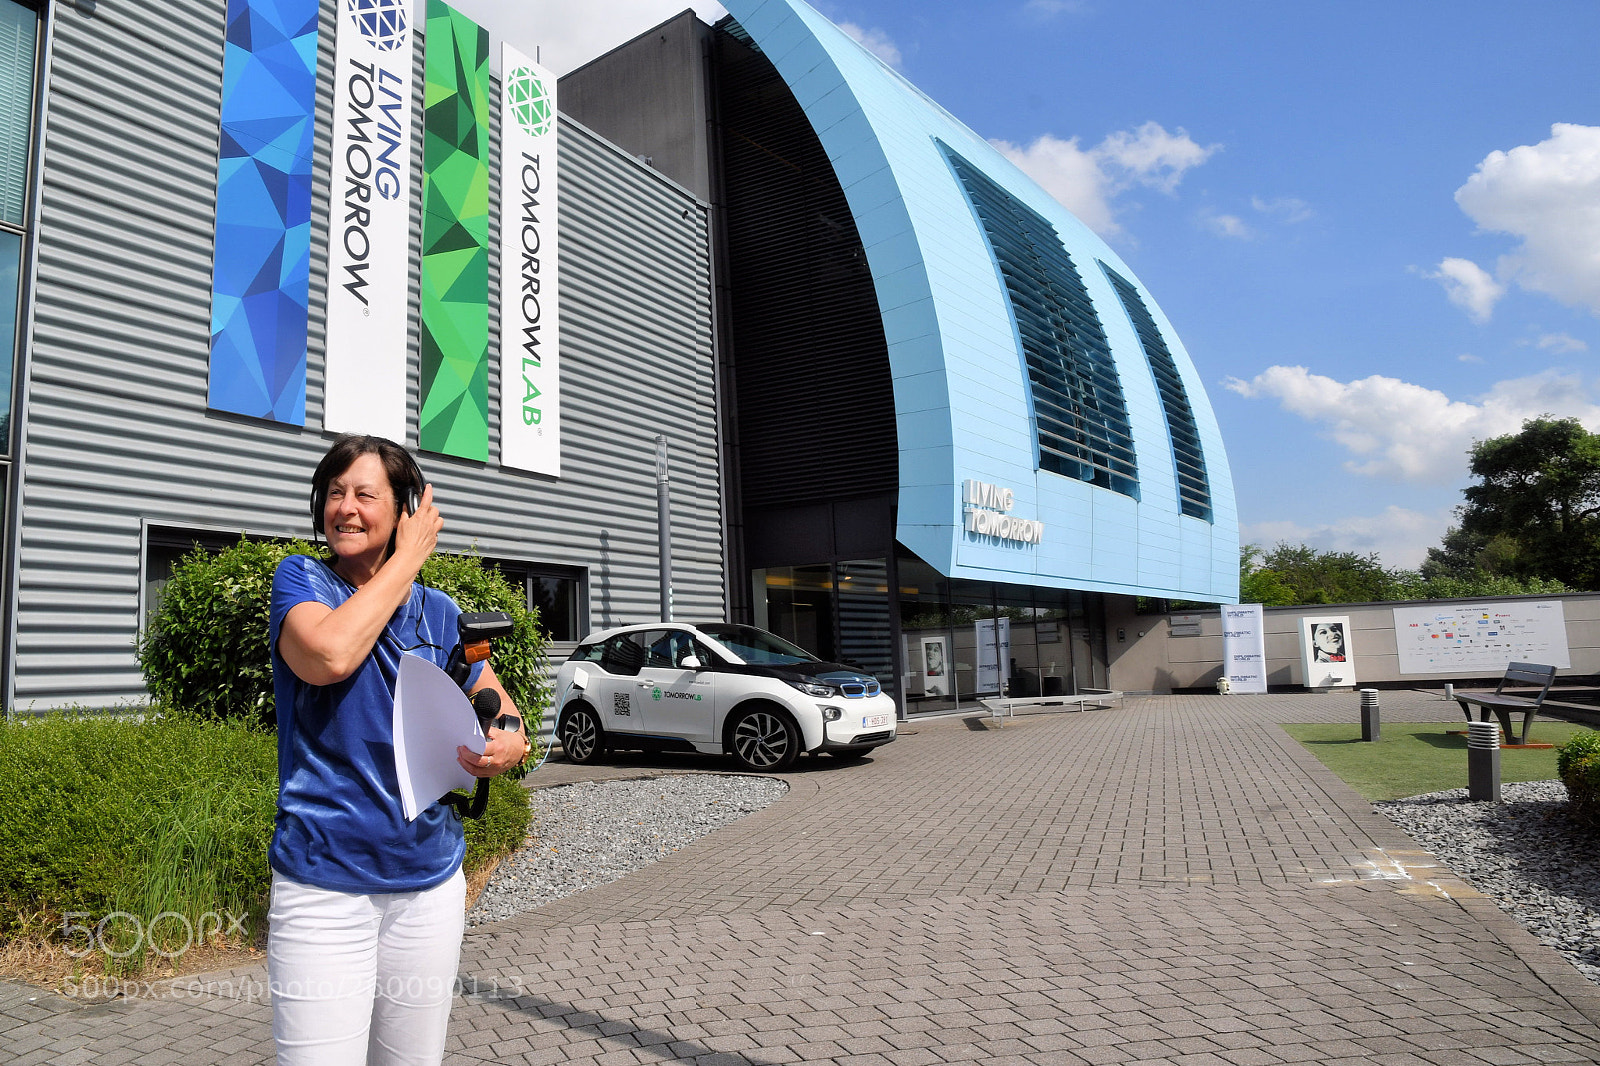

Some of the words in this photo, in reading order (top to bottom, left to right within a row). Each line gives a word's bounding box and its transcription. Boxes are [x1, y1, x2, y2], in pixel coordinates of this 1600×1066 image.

[341, 58, 375, 307] TOMORROW
[375, 67, 403, 201] LIVING
[521, 151, 542, 427] TOMORROWLAB
[963, 479, 1014, 512] LIVING
[964, 507, 1045, 545] TOMORROW
